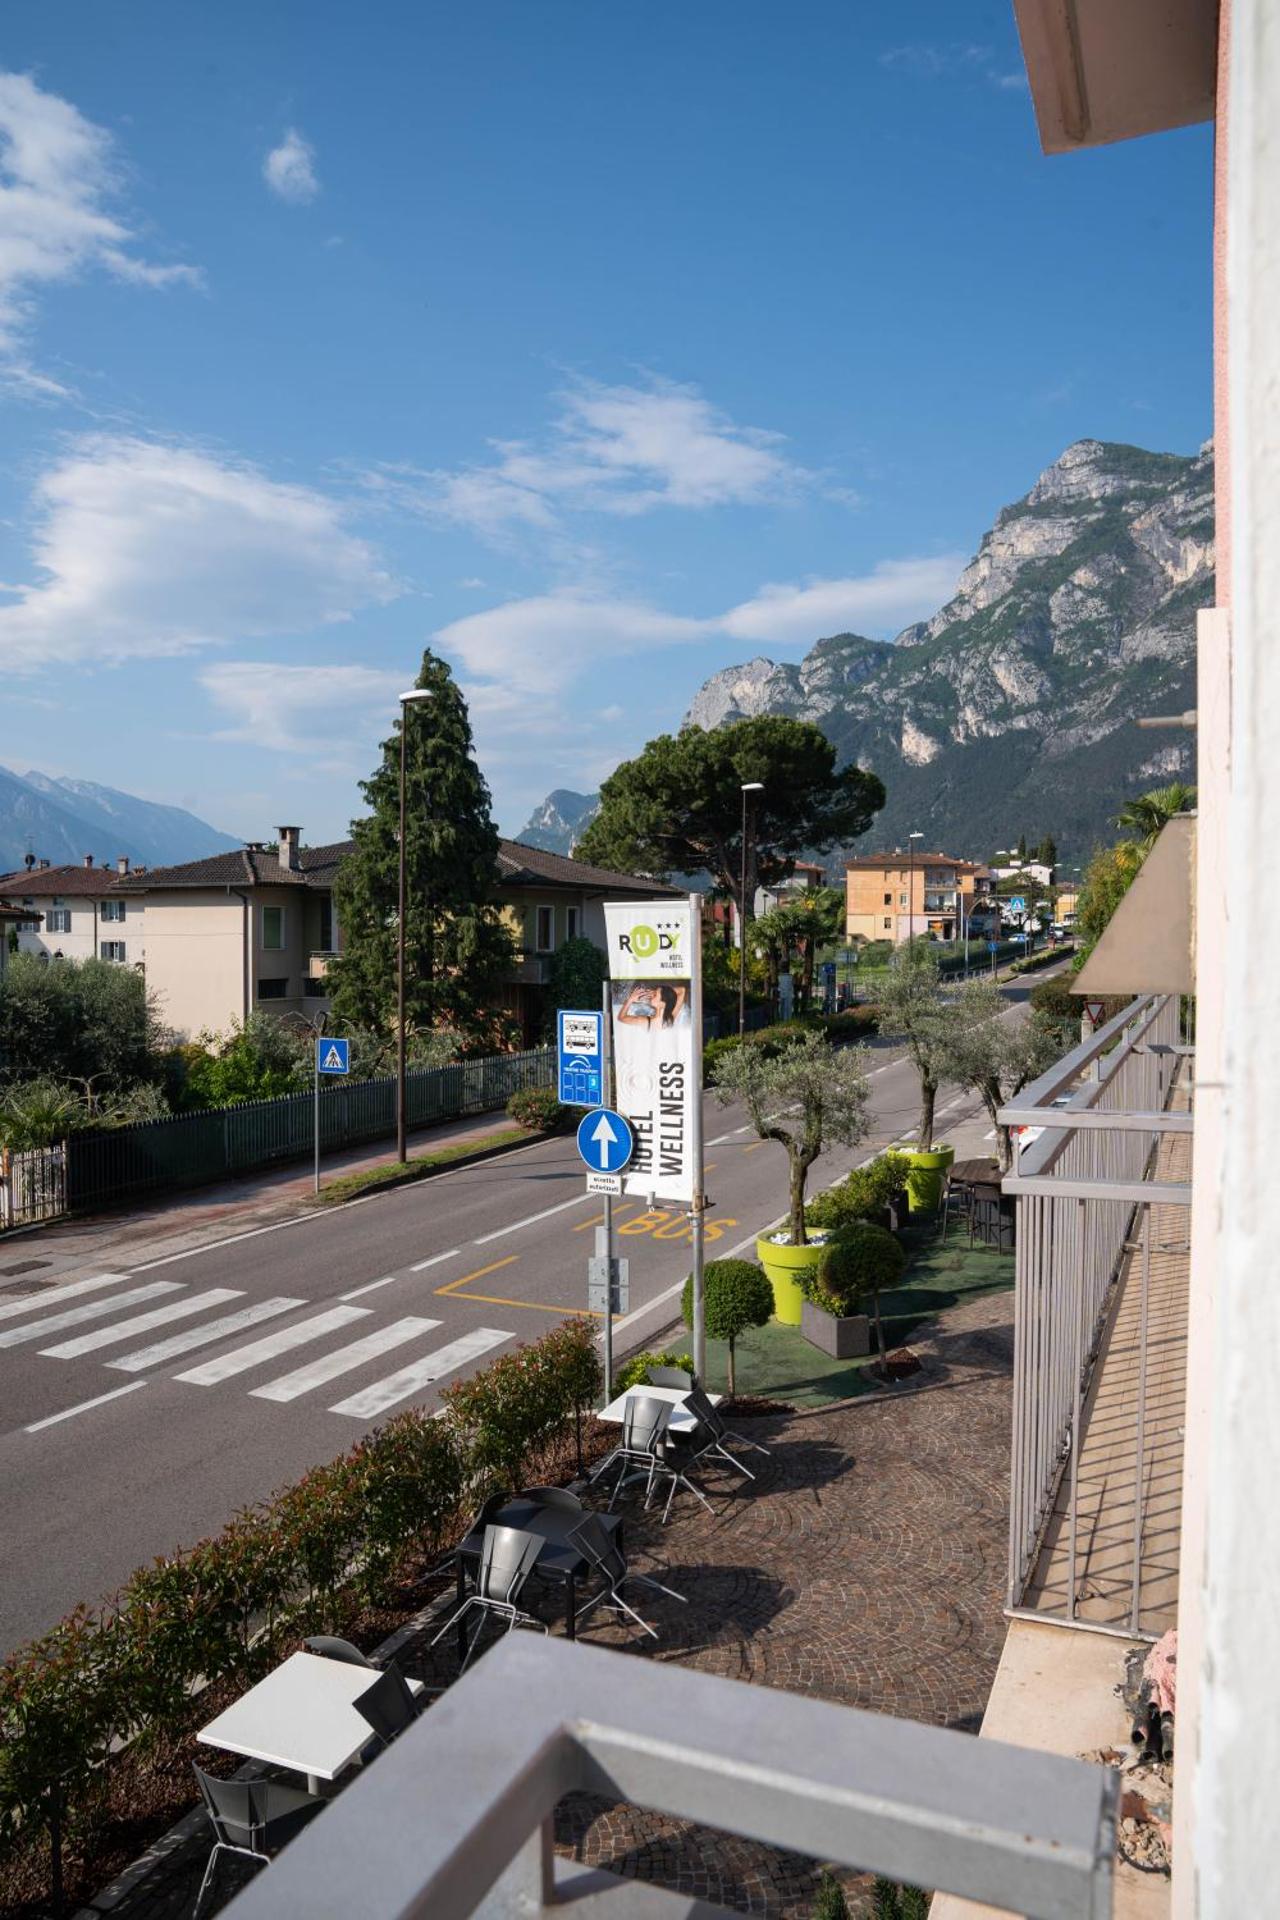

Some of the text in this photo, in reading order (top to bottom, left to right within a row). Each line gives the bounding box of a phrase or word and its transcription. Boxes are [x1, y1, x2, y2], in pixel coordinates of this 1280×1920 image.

[619, 927, 680, 956] RUDY
[629, 1111, 653, 1174] HOTEL
[659, 1062, 684, 1176] WELLNESS
[617, 1211, 737, 1242] BUS
